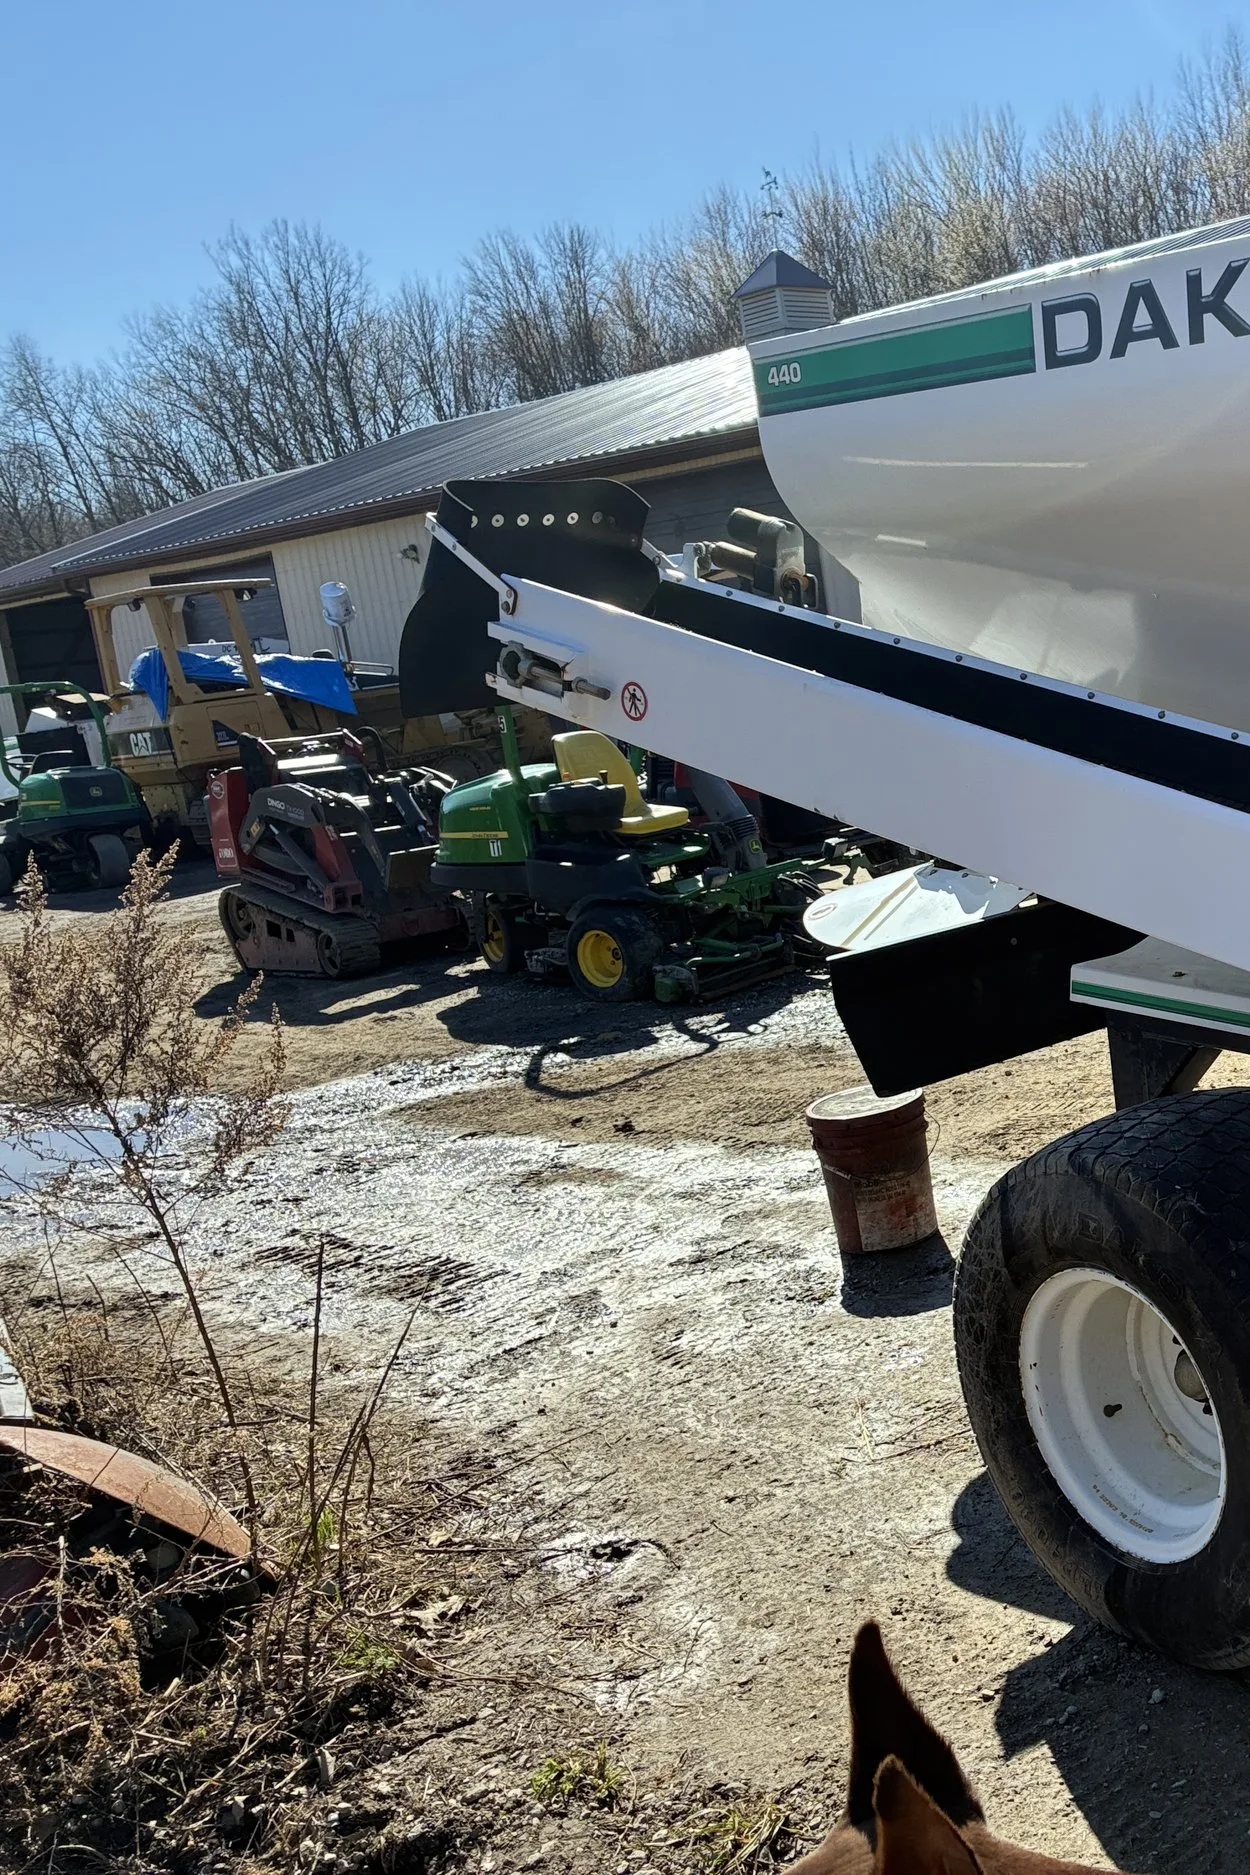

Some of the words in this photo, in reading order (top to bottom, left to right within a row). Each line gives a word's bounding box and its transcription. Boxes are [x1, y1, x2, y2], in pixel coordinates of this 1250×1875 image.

[768, 362, 801, 386] 440
[130, 731, 152, 757] CAT
[267, 798, 286, 810] DINGO
